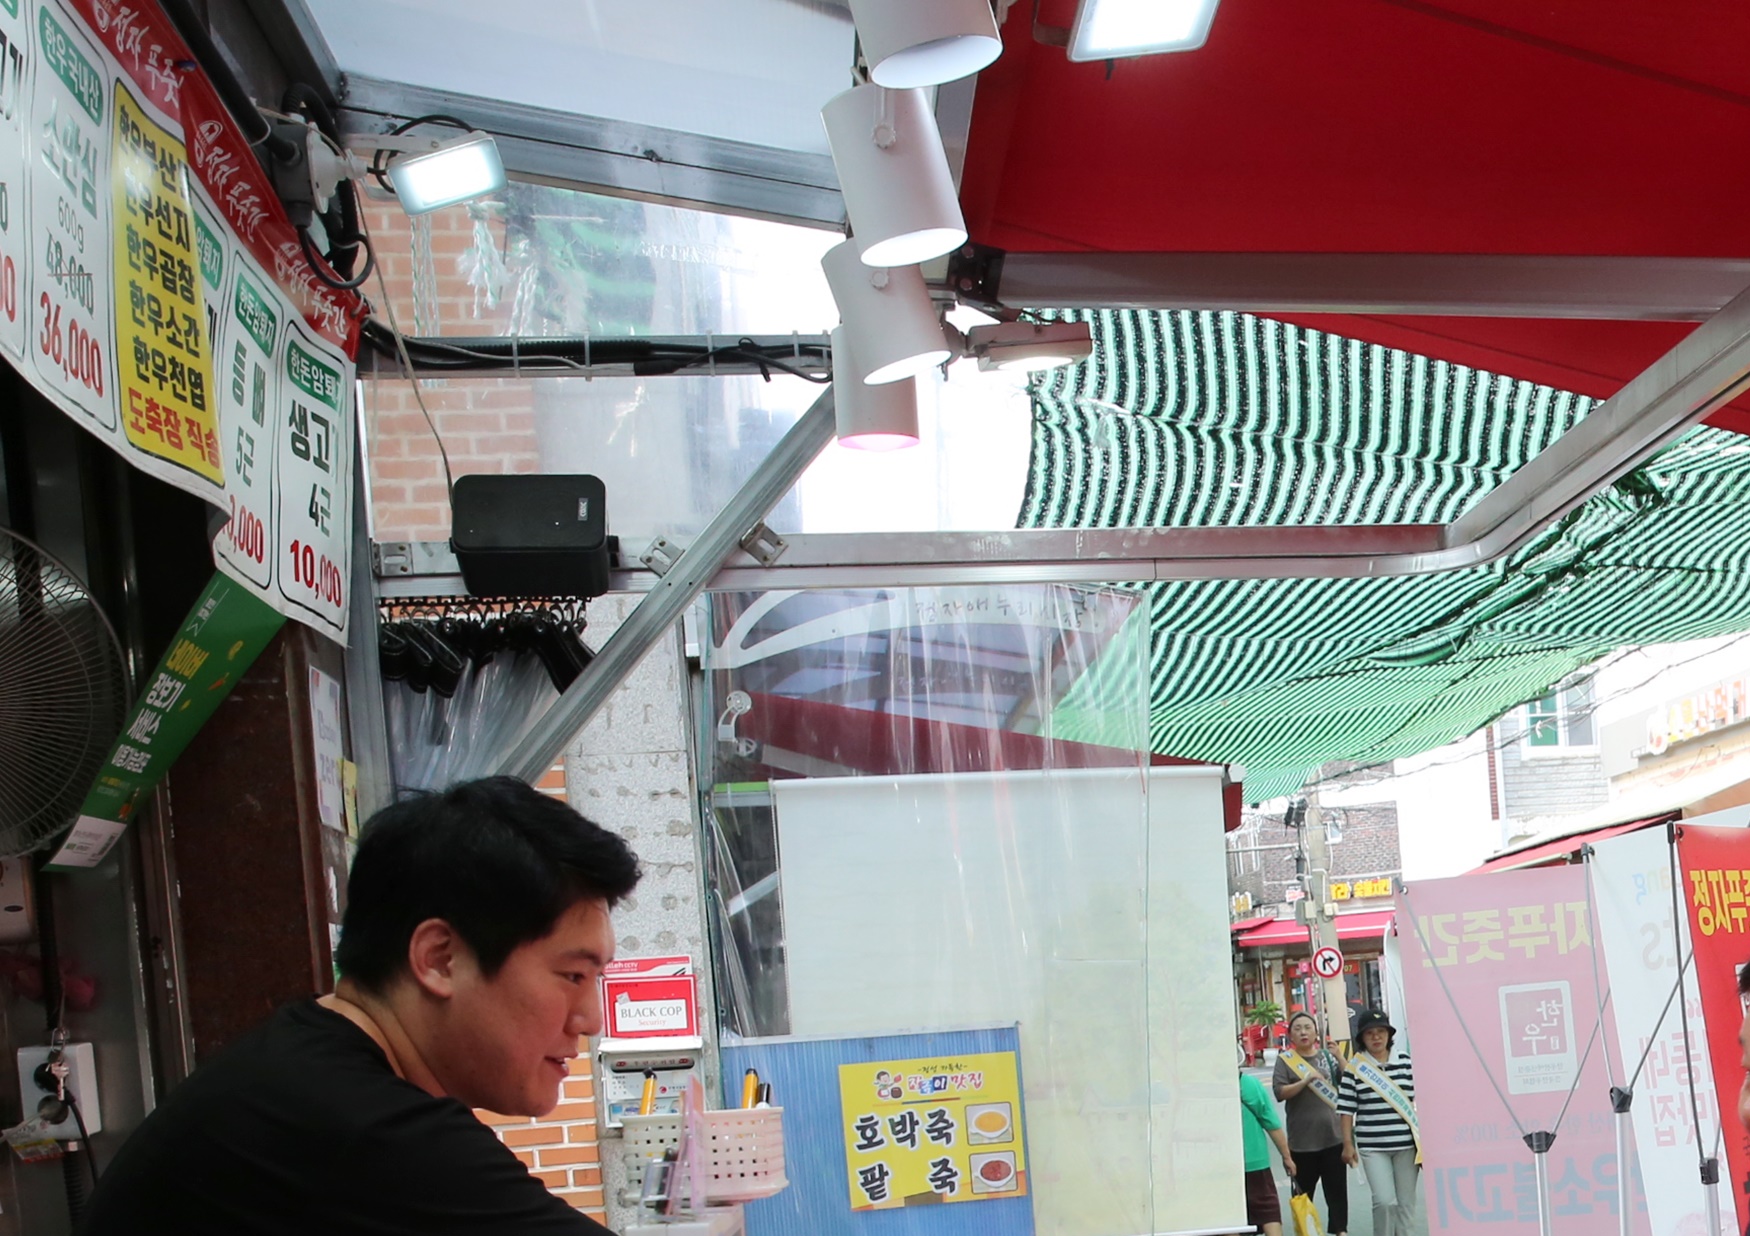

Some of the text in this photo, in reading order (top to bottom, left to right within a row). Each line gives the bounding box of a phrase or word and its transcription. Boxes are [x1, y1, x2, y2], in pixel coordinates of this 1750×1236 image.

[44, 16, 100, 117] 한우국내산
[57, 195, 85, 254] 600g
[205, 146, 269, 243] 정자 푸줏간
[126, 223, 196, 305] 한우곱창
[39, 291, 104, 398] 36,000
[129, 279, 201, 359] 한우소간
[311, 285, 348, 340] 푸줏간
[133, 335, 207, 412] 한우천엽
[128, 386, 220, 469] 도축장 직송
[309, 482, 332, 537] 4근
[289, 539, 343, 608] 10,000
[620, 1005, 682, 1019] BLACK COP
[638, 1018, 667, 1027] Security
[950, 1071, 984, 1091] 맛집
[855, 1108, 955, 1151] 호박죽
